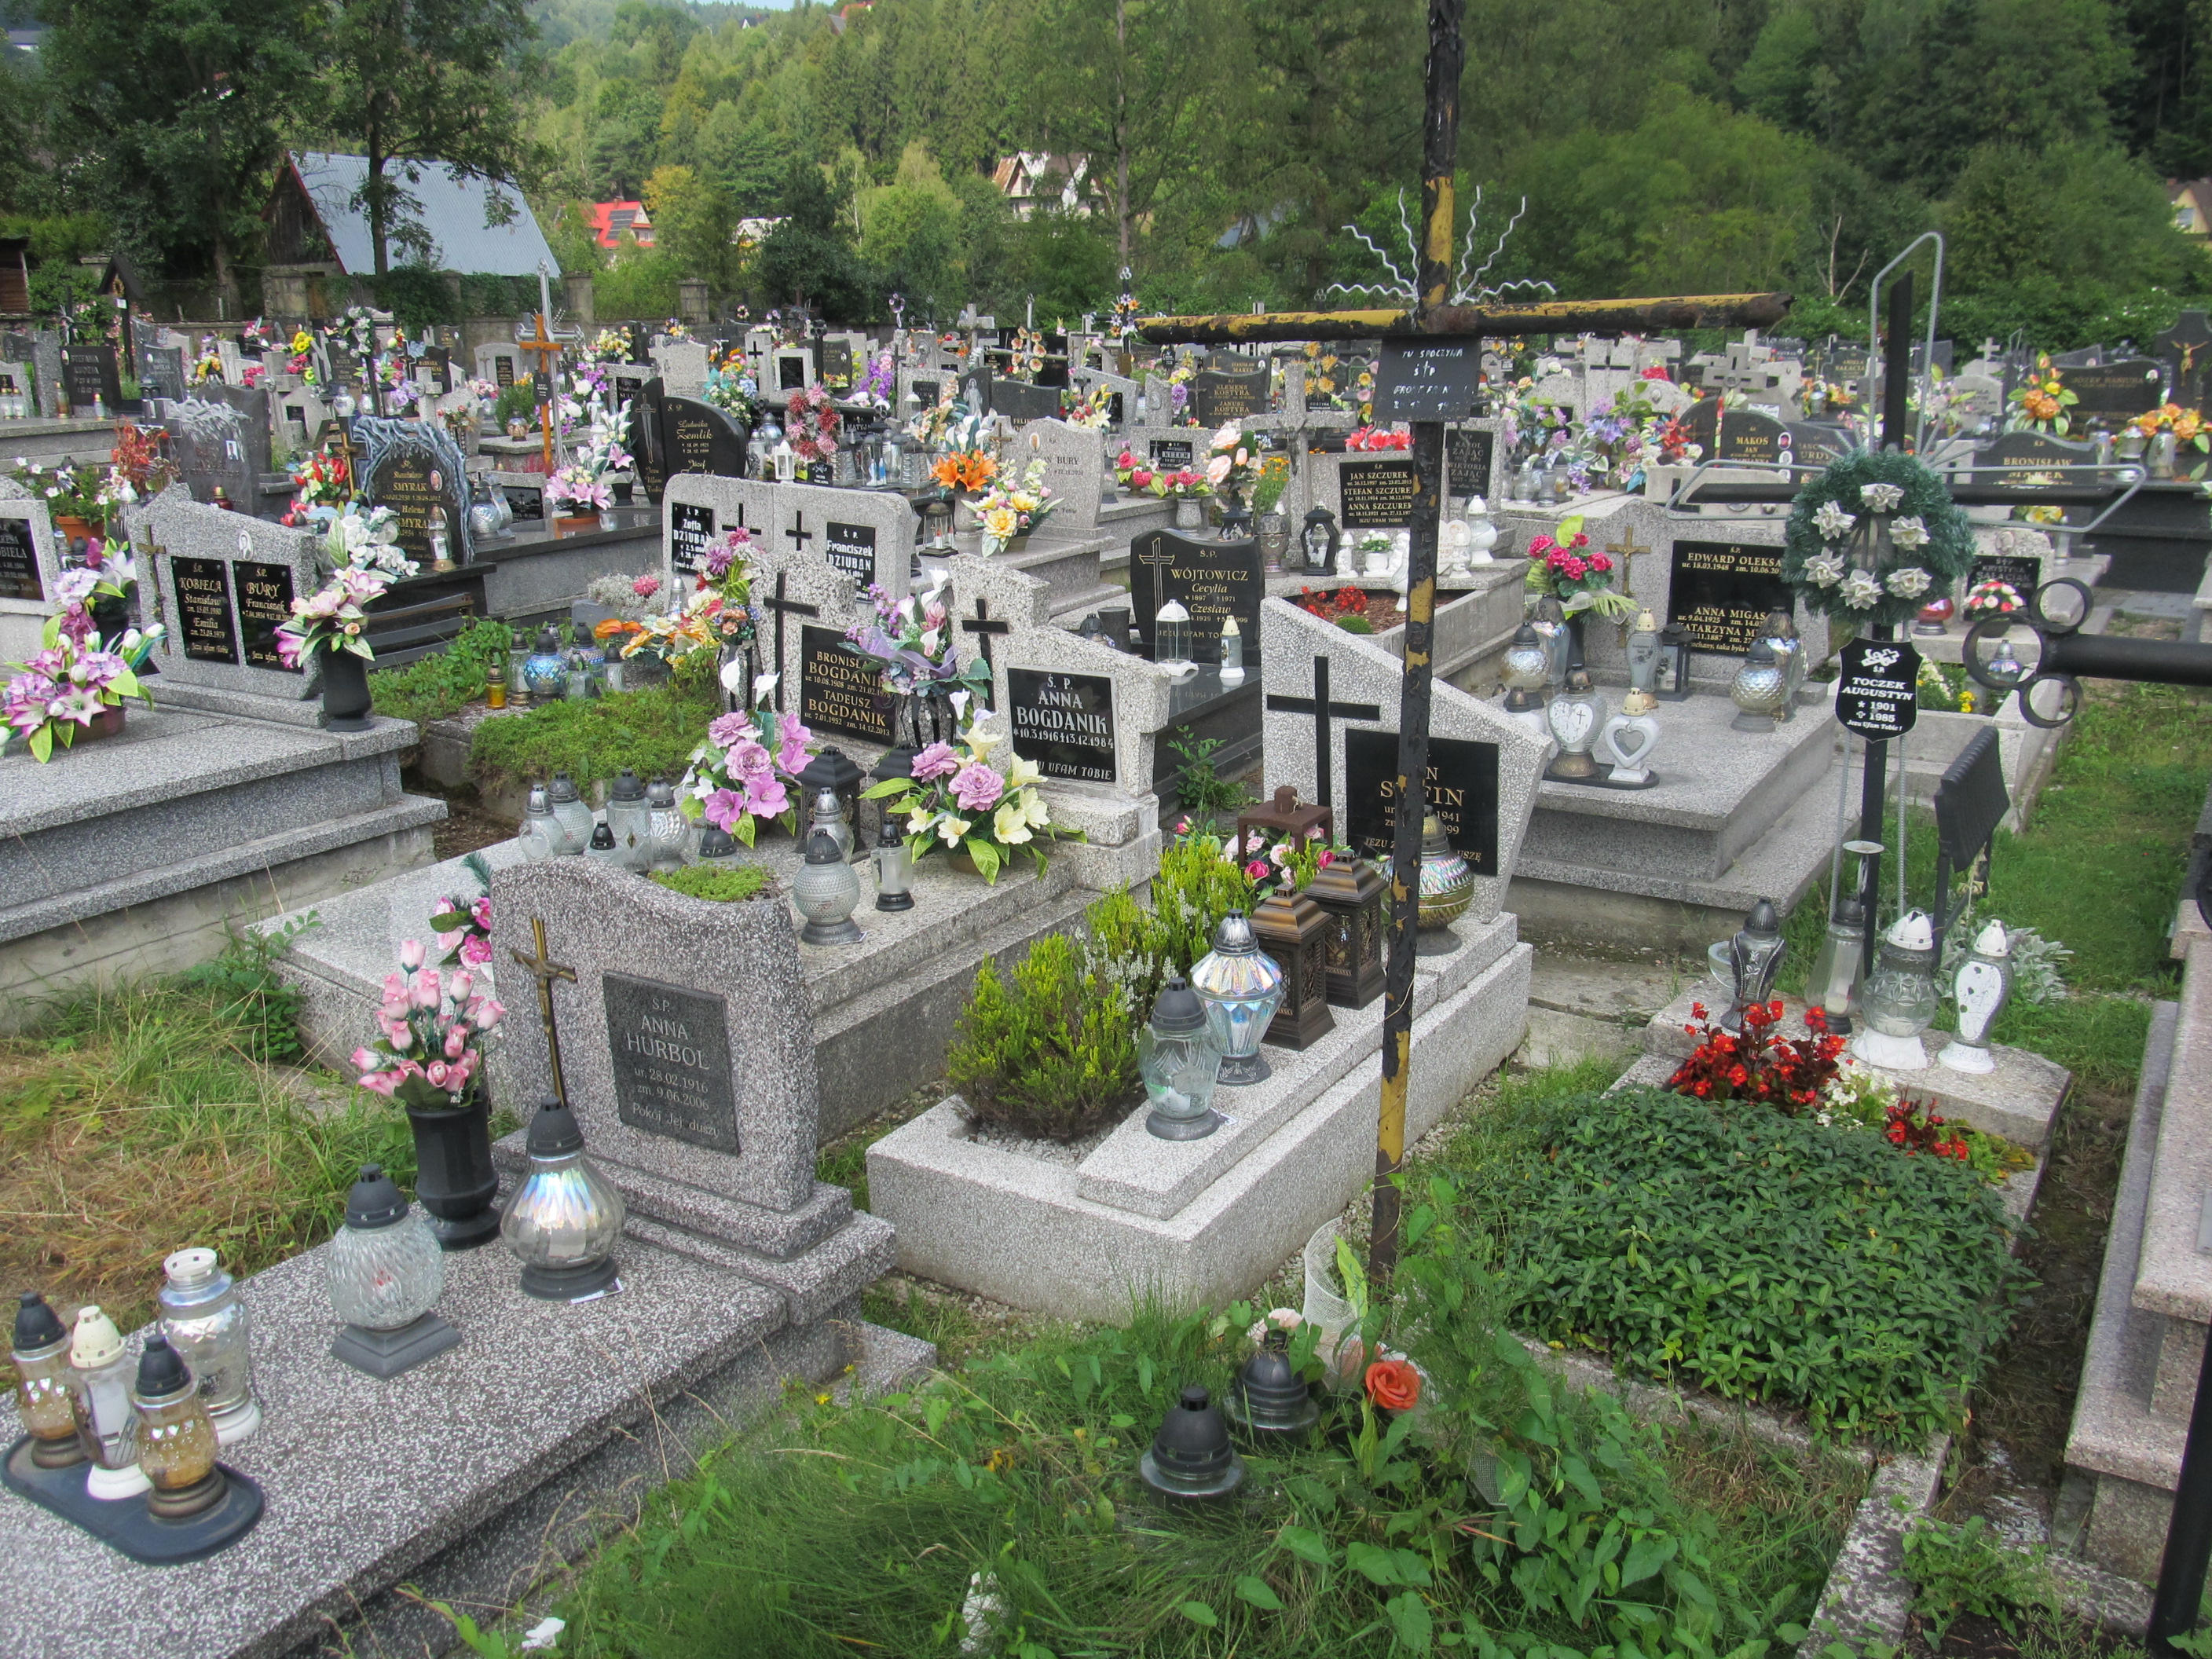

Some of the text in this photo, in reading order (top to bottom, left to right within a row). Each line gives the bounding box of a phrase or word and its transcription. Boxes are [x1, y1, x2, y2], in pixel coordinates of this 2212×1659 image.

[676, 429, 712, 440] Zemlik
[1057, 456, 1079, 465] BURY
[1448, 462, 1487, 471] WIKTORIA
[2003, 457, 2073, 466] BRONISŁAW
[1451, 469, 1481, 478] ZAJĄC
[393, 482, 427, 492] SMYRAK
[402, 505, 425, 514] Helena
[397, 518, 430, 529] SMYRA
[673, 529, 708, 545] DZIUBA
[826, 540, 873, 557] Franciszek
[828, 554, 871, 571] DZIUBAN
[1687, 552, 1735, 564] EDWARD
[1693, 562, 1730, 571] 18.03.1948
[1171, 566, 1248, 582] WÓJTOWICZ
[179, 577, 222, 592] KOBIELA
[247, 582, 280, 599] BURY
[1192, 583, 1229, 595] Cecylia
[185, 594, 222, 606] Stanisław
[246, 598, 287, 613] Franciszek
[1190, 603, 1232, 613] Czesław
[1694, 606, 1725, 617] ANNA
[193, 617, 218, 628] Emilia
[1688, 615, 1721, 624] 9.04.1925
[816, 650, 867, 669] BRONISŁA
[814, 676, 844, 689] 10.08.1908
[1852, 677, 1906, 690] TOCZEK
[823, 690, 870, 709] TADEUSZ
[1038, 690, 1083, 709] ANNA
[1842, 687, 1914, 701] AUGUSTYN
[808, 698, 886, 727] BOGDANIK
[1870, 701, 1896, 712] 1901
[1016, 705, 1108, 734] BOGDANIK
[1870, 712, 1895, 723] 1985
[815, 713, 842, 726] 7.01.1952
[859, 723, 890, 736] 14.12.2013
[1048, 762, 1078, 775] UFAM
[1081, 766, 1112, 781] TOBIE
[1365, 837, 1388, 848] JEZU
[1457, 850, 1481, 862] USZĘ
[641, 1015, 688, 1040] ANNA
[627, 1033, 710, 1070] HURBOL
[635, 1068, 709, 1093] ur. 28.02.1916
[637, 1086, 709, 1111] zm. 9.06.2006
[668, 1112, 683, 1129] Jej
[689, 1120, 720, 1139] duszy
